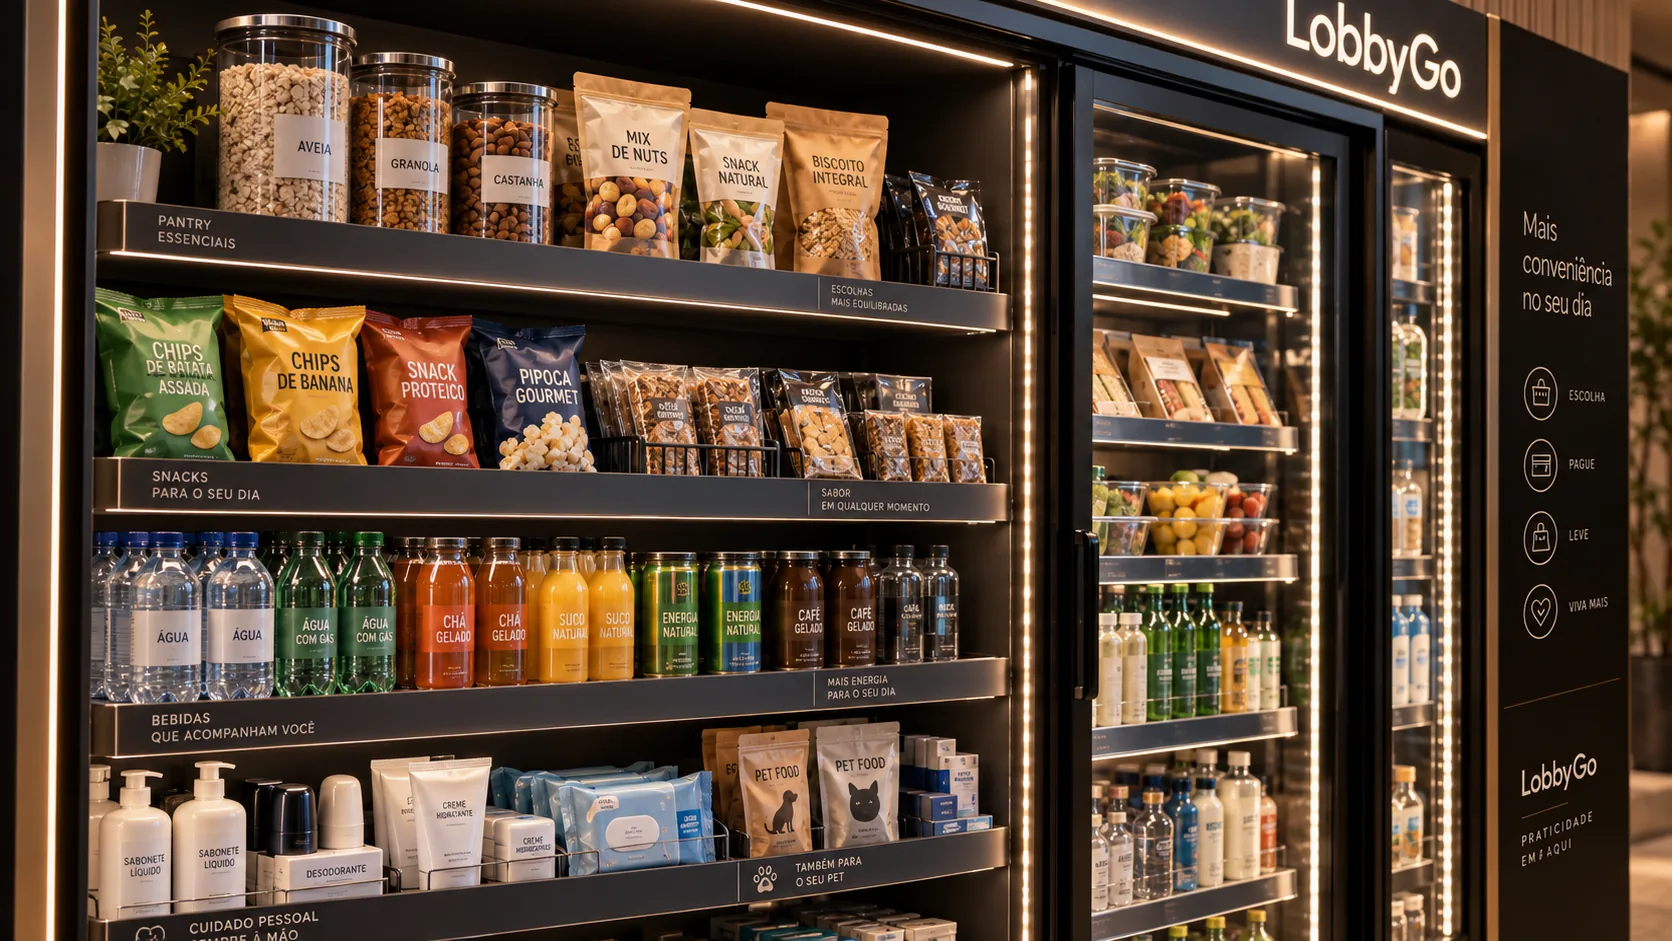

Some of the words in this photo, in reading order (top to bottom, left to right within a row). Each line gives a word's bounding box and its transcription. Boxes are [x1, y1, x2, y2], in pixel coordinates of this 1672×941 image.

[1287, 0, 1462, 98] LobbyGo
[626, 129, 651, 146] MIX
[297, 139, 332, 156] AVEIA
[612, 145, 630, 160] DE
[633, 147, 668, 165] NUTS
[391, 158, 440, 173] GRANOLA
[723, 156, 760, 173] SNACK
[812, 155, 865, 173] BISCOITO
[493, 174, 545, 189] CASTANHA
[718, 171, 768, 189] NATURAL
[813, 171, 868, 189] INTEGRAL
[158, 214, 212, 231] PANTRY
[1523, 210, 1558, 242] Mais
[157, 231, 236, 249] ESSENCIAIS
[1522, 255, 1613, 287] conveniência
[831, 284, 873, 297] ESCOLHAS
[831, 298, 850, 308] MAIS
[853, 299, 908, 313] EQUILIBRADAS
[1523, 291, 1541, 312] no
[1545, 294, 1569, 314] seu
[1572, 291, 1592, 317] dia
[152, 341, 203, 361] CHIPS
[146, 360, 165, 374] DE
[168, 361, 213, 376] BATATA
[291, 351, 340, 372] CHIPS
[407, 360, 457, 382] SNACK
[519, 368, 572, 387] PIPOCA
[159, 380, 210, 396] ASSADA
[277, 373, 297, 390] DE
[301, 374, 354, 394] BANANA
[401, 381, 465, 401] PROTEICO
[516, 387, 578, 405] GOURMET
[1569, 389, 1606, 403] ESCOLHA
[1569, 458, 1595, 470] PAGUE
[152, 470, 208, 483] SNACKS
[152, 487, 188, 499] PARA
[193, 488, 203, 499] O
[208, 488, 233, 500] SEU
[238, 489, 260, 500] DIA
[821, 488, 851, 498] SABOR
[821, 501, 835, 511] EM
[837, 501, 884, 512] QUALQUER
[887, 502, 930, 512] MOMENTO
[1569, 529, 1589, 541] LEVE
[1568, 600, 1587, 613] VIVA
[1589, 596, 1609, 610] MAIS
[443, 611, 466, 629] CHÁ
[499, 610, 521, 627] CHÁ
[559, 612, 584, 627] SUCO
[606, 612, 631, 625] SUCO
[662, 611, 698, 624] ENERGIA
[726, 609, 761, 622] ENERGIA
[798, 606, 820, 622] CAFÉ
[851, 605, 872, 620] CAFÉ
[302, 617, 329, 631] ÁGUA
[362, 616, 388, 630] ÁGUA
[726, 624, 760, 636] NATURAL
[794, 621, 823, 634] GELADO
[847, 620, 874, 632] GELADO
[157, 629, 189, 644] ÁGUA
[232, 627, 262, 641] ÁGUA
[296, 634, 317, 645] COM
[356, 632, 376, 643] COM
[436, 630, 471, 644] GELADO
[492, 628, 526, 641] GELADO
[553, 627, 588, 640] NATURAL
[600, 626, 633, 638] NATURAL
[663, 626, 697, 638] NATURAL
[827, 676, 849, 687] MAIS
[851, 675, 888, 686] ENERGIA
[827, 690, 850, 700] PARA
[852, 689, 860, 699] O
[862, 688, 879, 698] SEU
[881, 687, 896, 697] DIA
[152, 712, 211, 727] BEBIDAS
[151, 730, 179, 744] QUE
[184, 725, 278, 742] ACOMPANHAM
[282, 720, 315, 736] VOCÊ
[835, 758, 855, 772] PET
[858, 756, 886, 771] FOOD
[755, 767, 773, 782] PET
[775, 764, 800, 779] FOOD
[1521, 752, 1597, 797] LobbyGo
[1521, 810, 1593, 847] PRATICIDADE
[198, 845, 240, 858] SABONETE
[1521, 852, 1536, 867] EM
[1546, 838, 1573, 858] AQUI
[124, 854, 165, 866] SABONETE
[204, 857, 235, 869] LÍQUIDO
[795, 857, 835, 873] TAMBÉM
[838, 855, 862, 868] PARA
[130, 865, 161, 878] LÍQUIDO
[306, 864, 367, 879] DESODORANTE
[796, 877, 804, 887] O
[806, 874, 825, 886] SEU
[827, 871, 845, 883] PET
[189, 917, 254, 935] CUIDADO
[259, 910, 319, 927] PESSOAL
